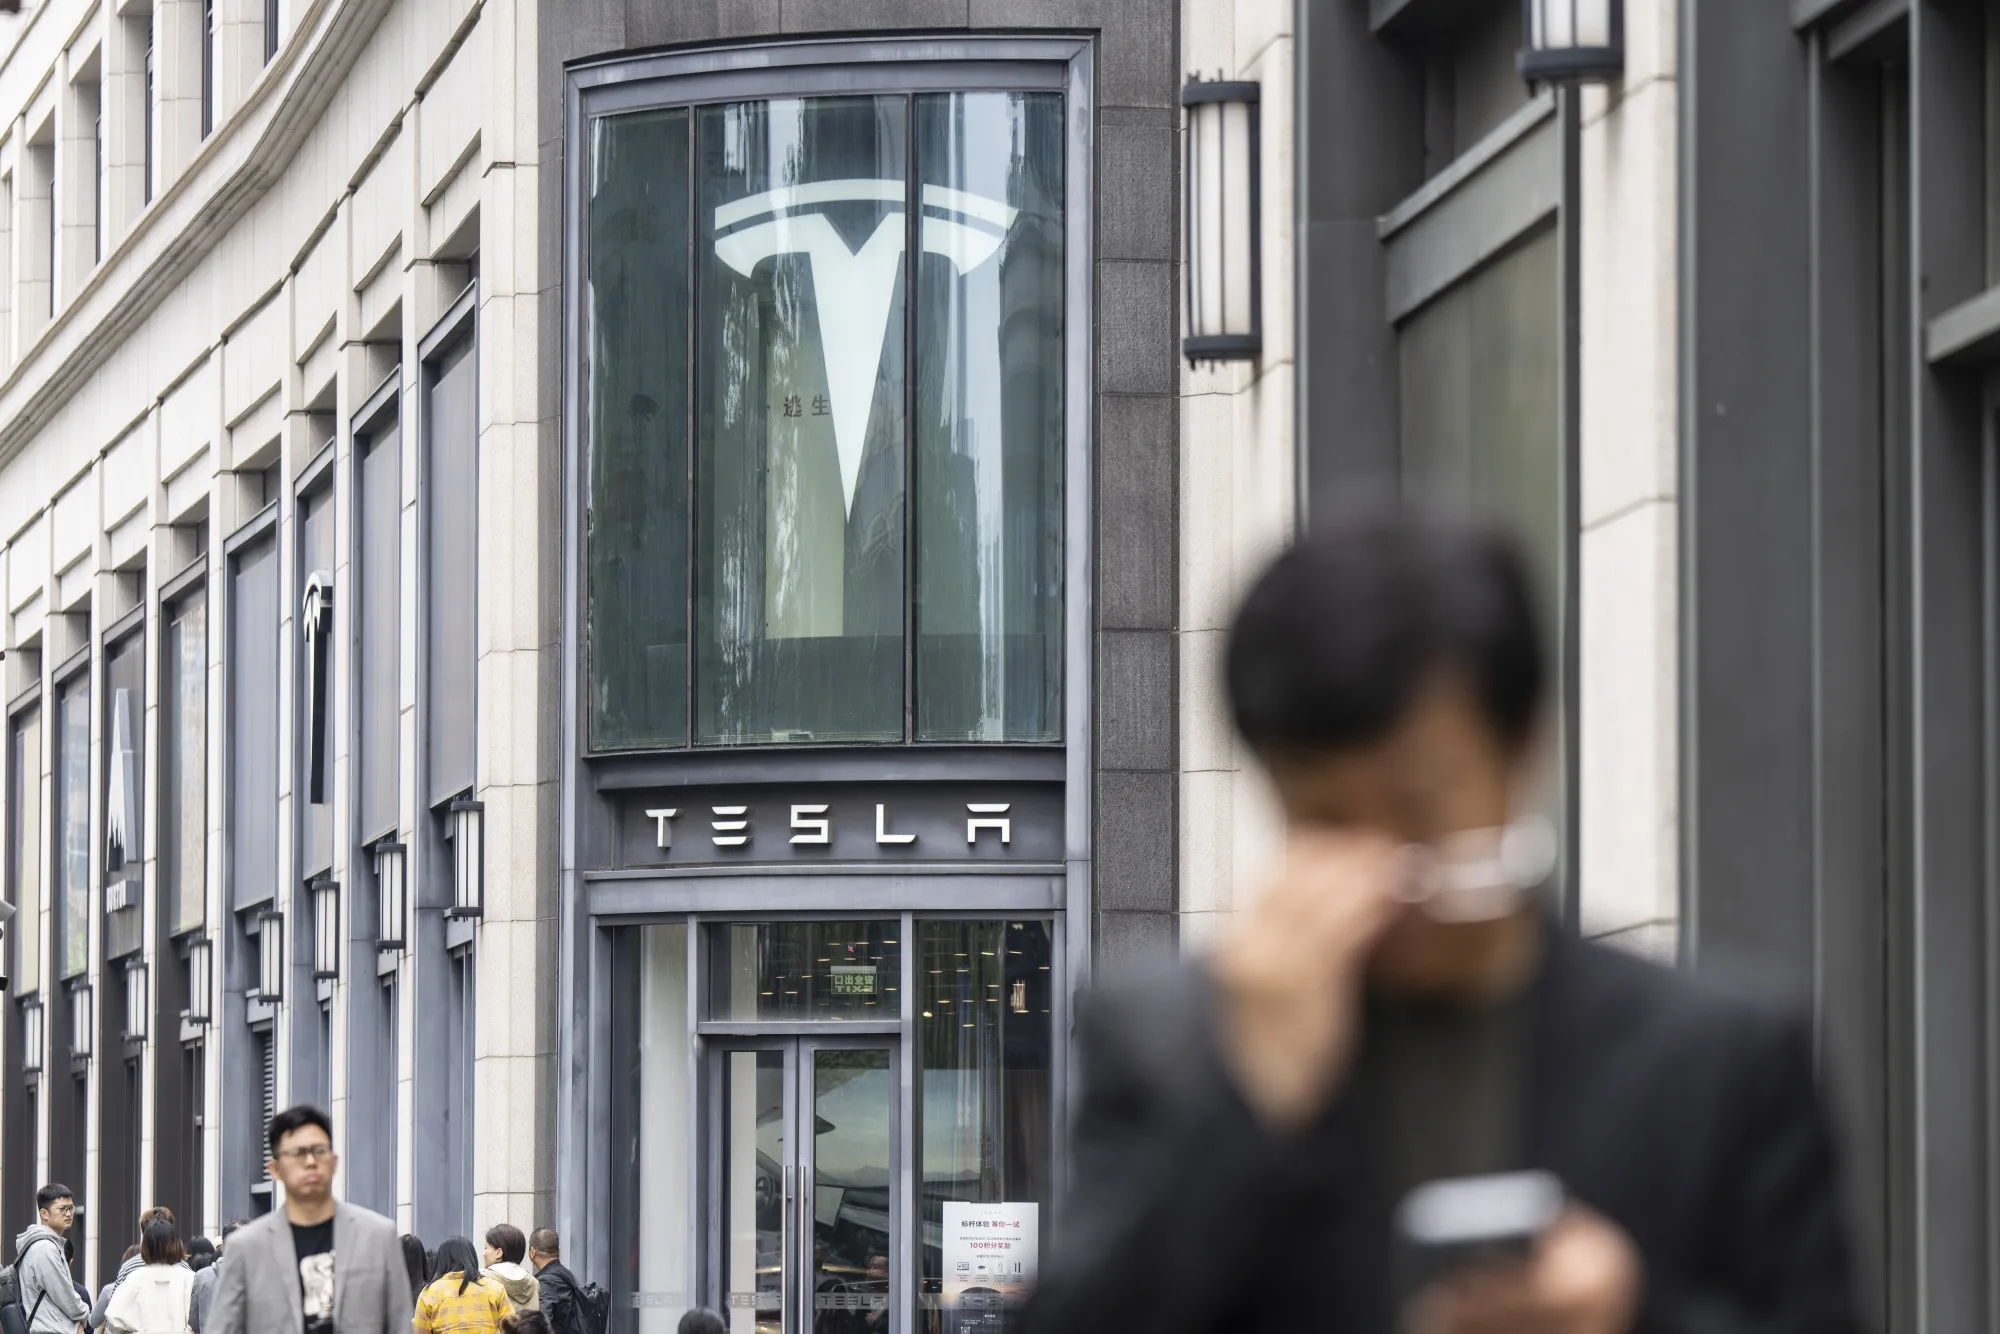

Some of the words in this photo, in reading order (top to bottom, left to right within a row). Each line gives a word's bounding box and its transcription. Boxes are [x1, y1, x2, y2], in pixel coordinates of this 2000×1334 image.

[783, 394, 830, 417] 逃生
[645, 803, 1010, 848] TESLA
[821, 1295, 885, 1306] TESLA
